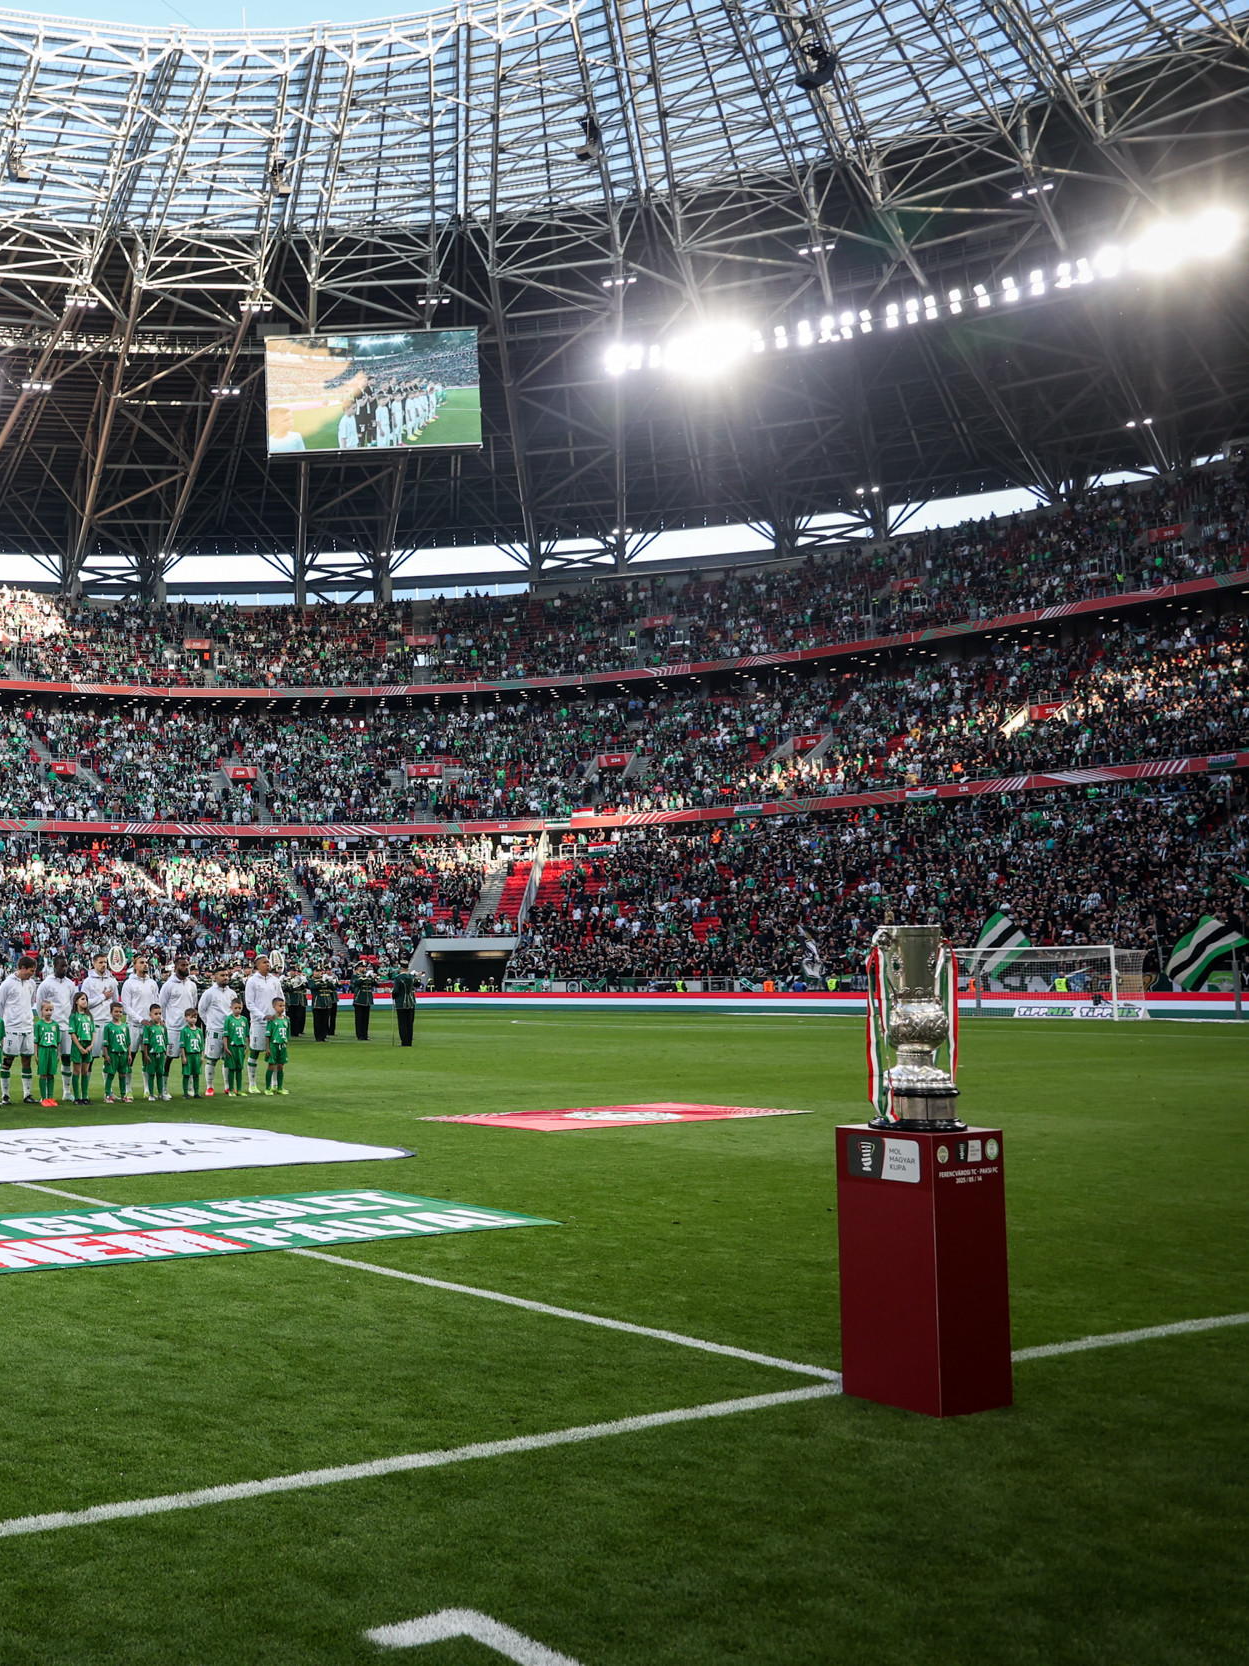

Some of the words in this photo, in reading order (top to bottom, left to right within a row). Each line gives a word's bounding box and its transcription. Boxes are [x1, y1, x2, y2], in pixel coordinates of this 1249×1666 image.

[28, 1148, 224, 1164] KUPA
[889, 1147, 902, 1156] MOL
[889, 1156, 916, 1165] MAGYAR
[889, 1164, 907, 1172] KUPA
[939, 1169, 971, 1178] FERENCVÁROSI
[213, 1209, 527, 1247] PÁLYA!
